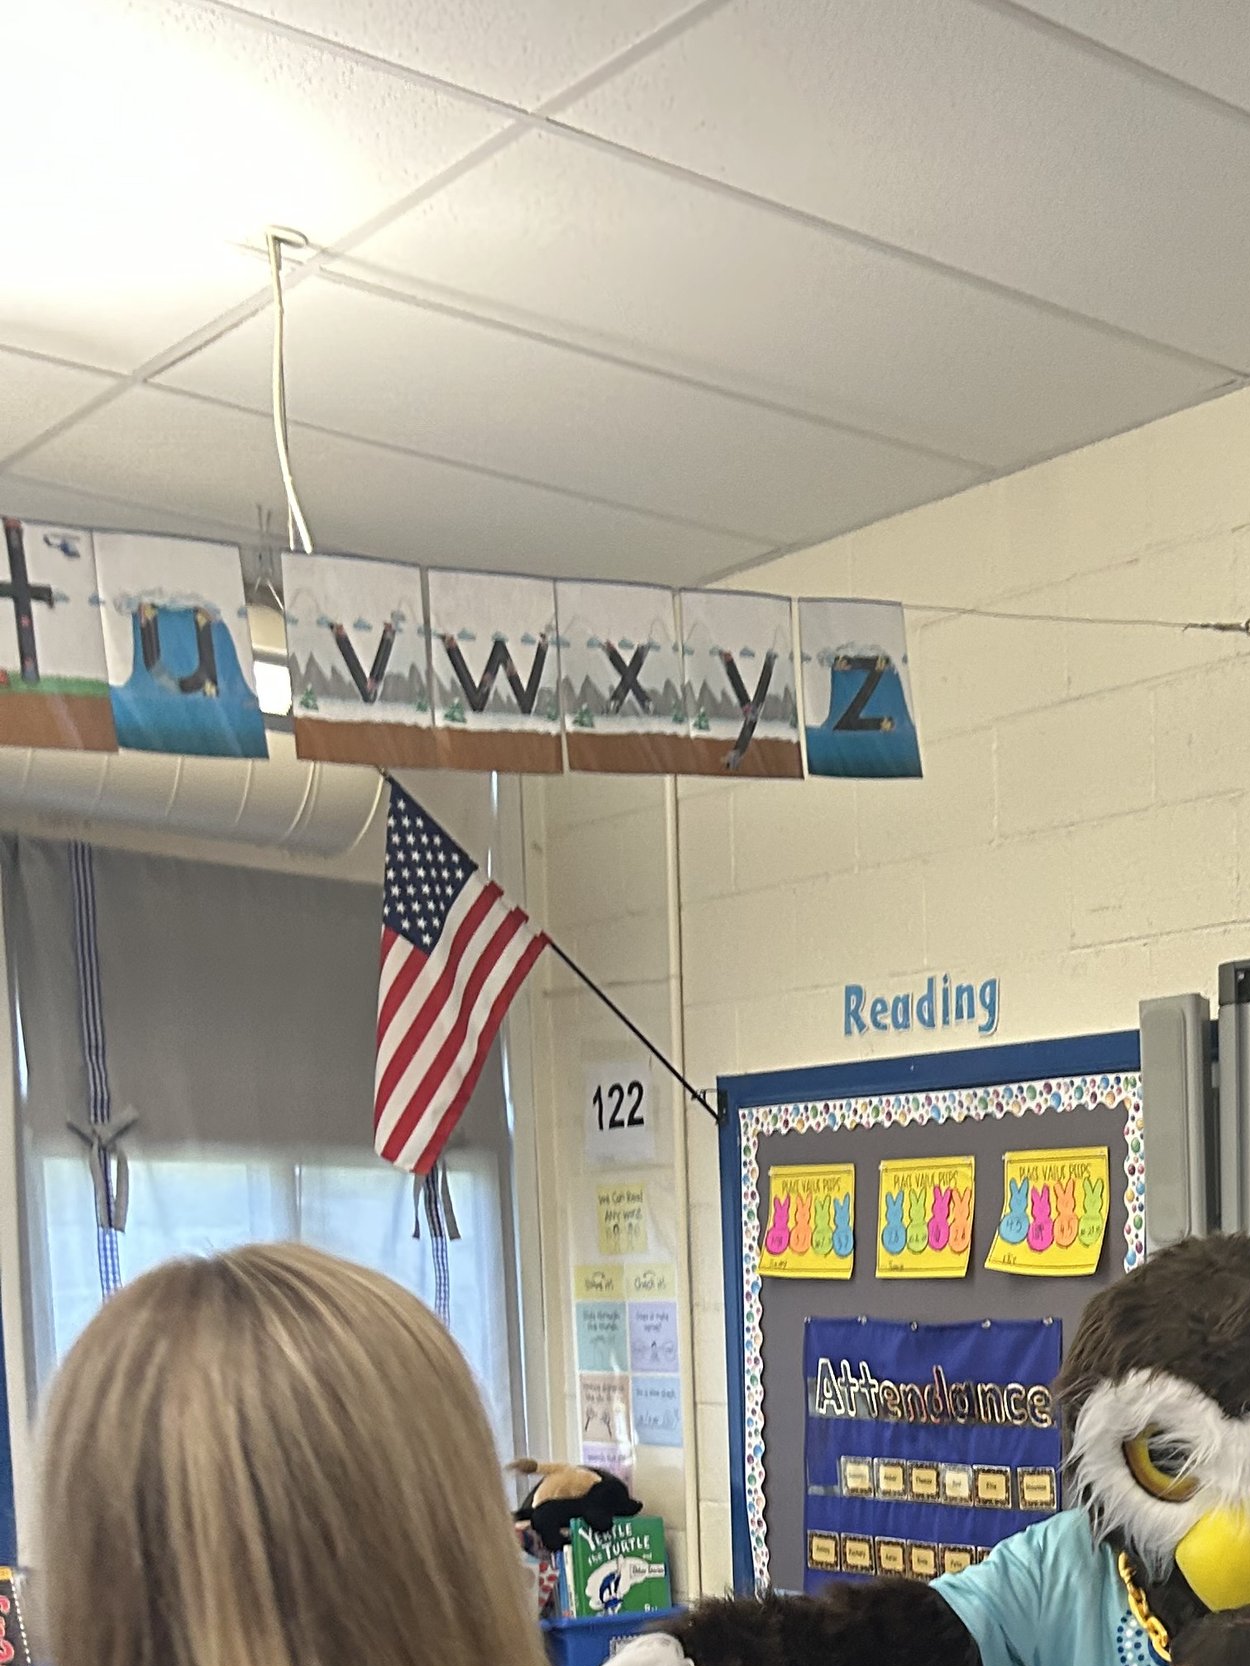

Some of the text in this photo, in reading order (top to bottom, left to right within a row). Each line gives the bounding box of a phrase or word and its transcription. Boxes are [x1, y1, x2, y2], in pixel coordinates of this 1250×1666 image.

[720, 652, 776, 770] y
[844, 973, 999, 1036] Reading
[592, 1079, 645, 1131] 122
[814, 1358, 1054, 1428] Attendance
[602, 1535, 650, 1560] TURTLE
